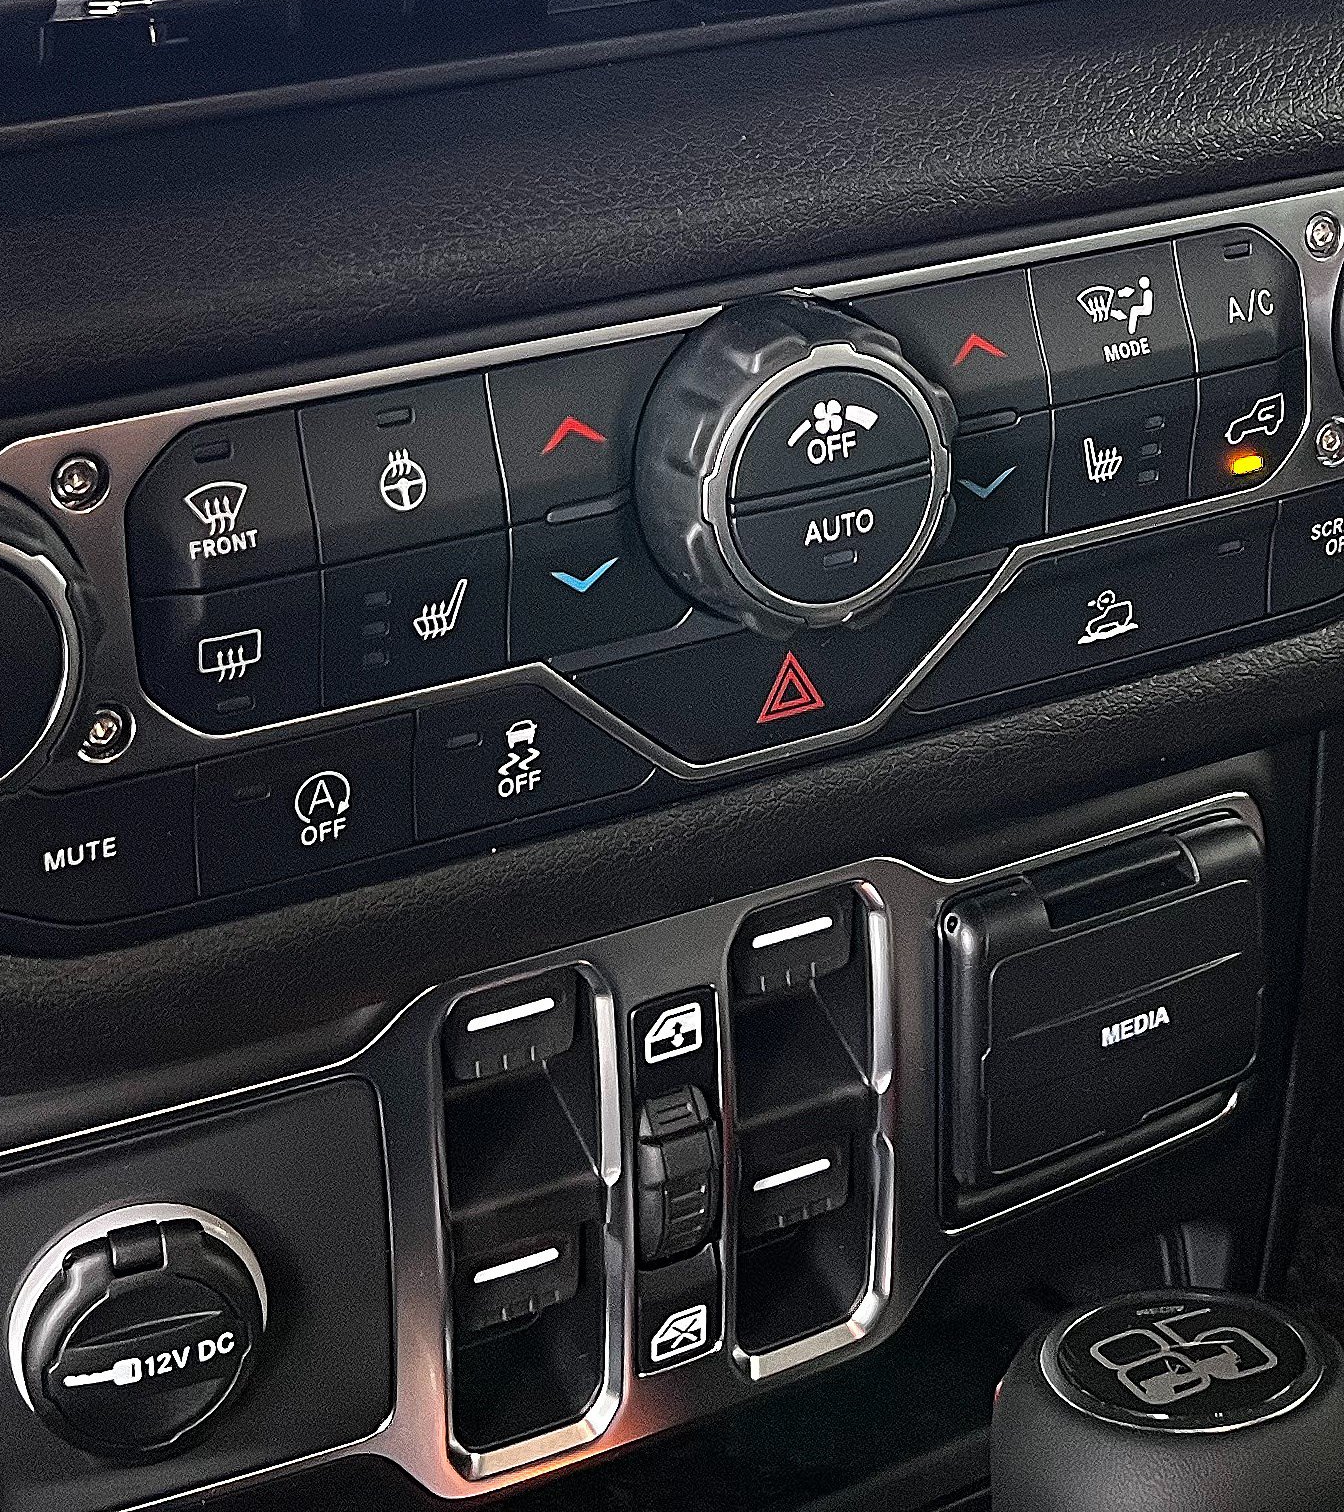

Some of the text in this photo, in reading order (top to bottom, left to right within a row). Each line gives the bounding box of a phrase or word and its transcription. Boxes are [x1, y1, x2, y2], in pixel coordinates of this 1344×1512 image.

[1228, 289, 1275, 324] A/C
[1103, 337, 1151, 363] MODE
[807, 430, 856, 465] OFF
[189, 529, 259, 560] FRONT
[804, 508, 874, 547] AUTO
[497, 769, 542, 798] OFF
[300, 817, 347, 846] OFF
[43, 837, 117, 873] MUTE
[1101, 1006, 1170, 1047] MEDIA
[144, 1331, 235, 1378] 12V DC
